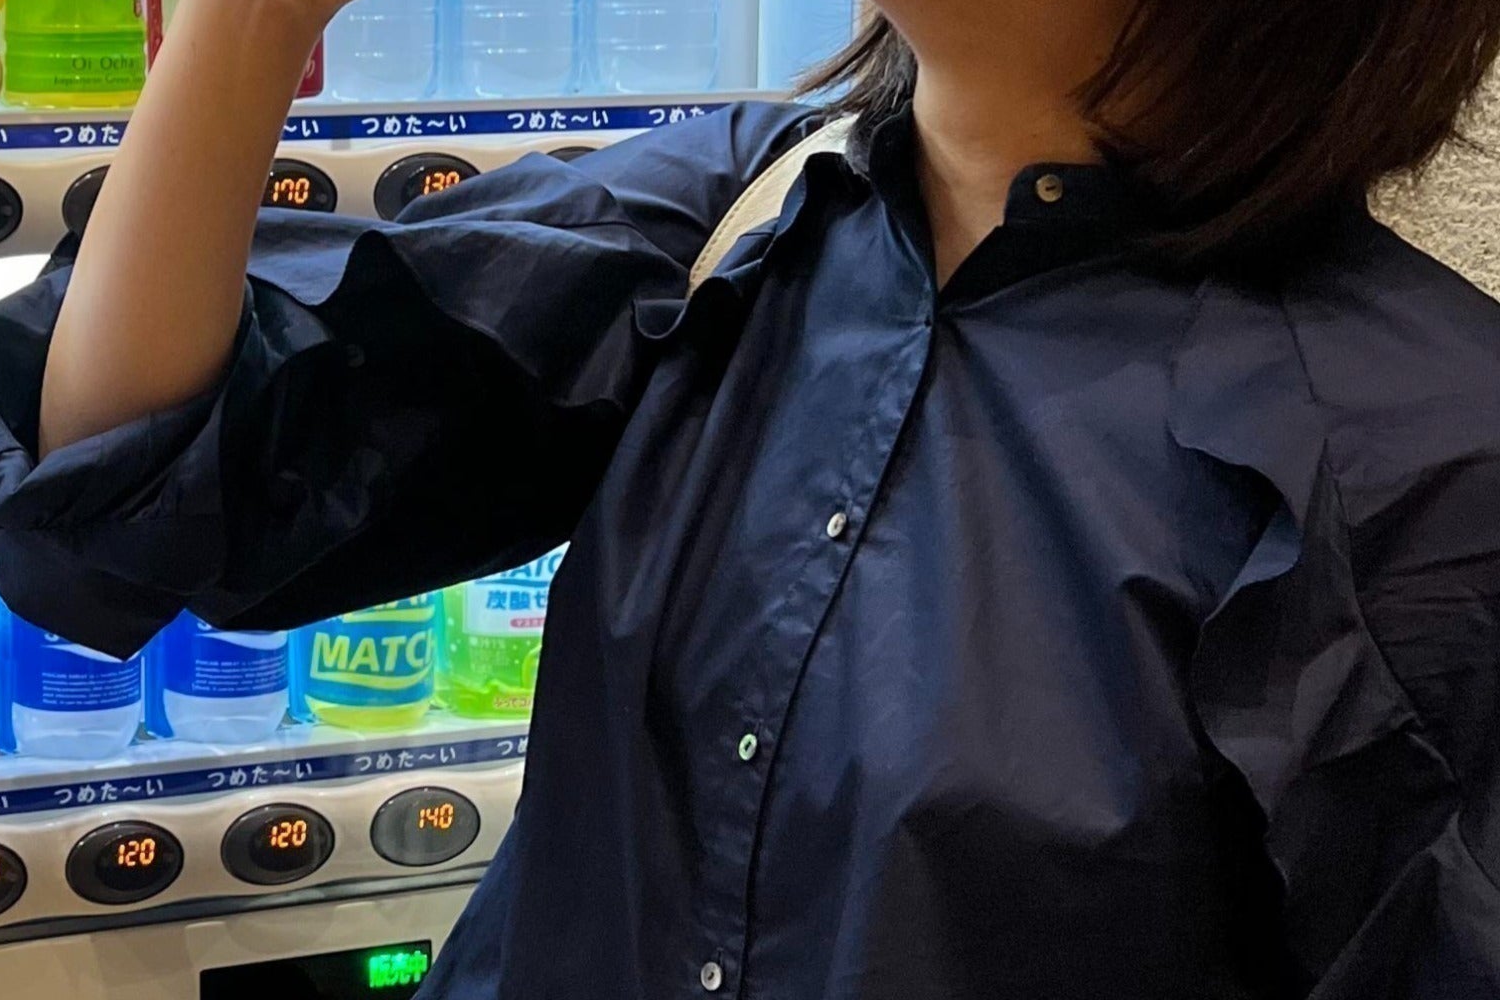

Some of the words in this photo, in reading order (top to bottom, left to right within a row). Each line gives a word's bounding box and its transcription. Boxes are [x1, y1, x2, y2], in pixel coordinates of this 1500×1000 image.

[272, 177, 310, 204] 170
[417, 803, 453, 829] 140
[269, 820, 306, 848] 120
[116, 839, 155, 867] 120
